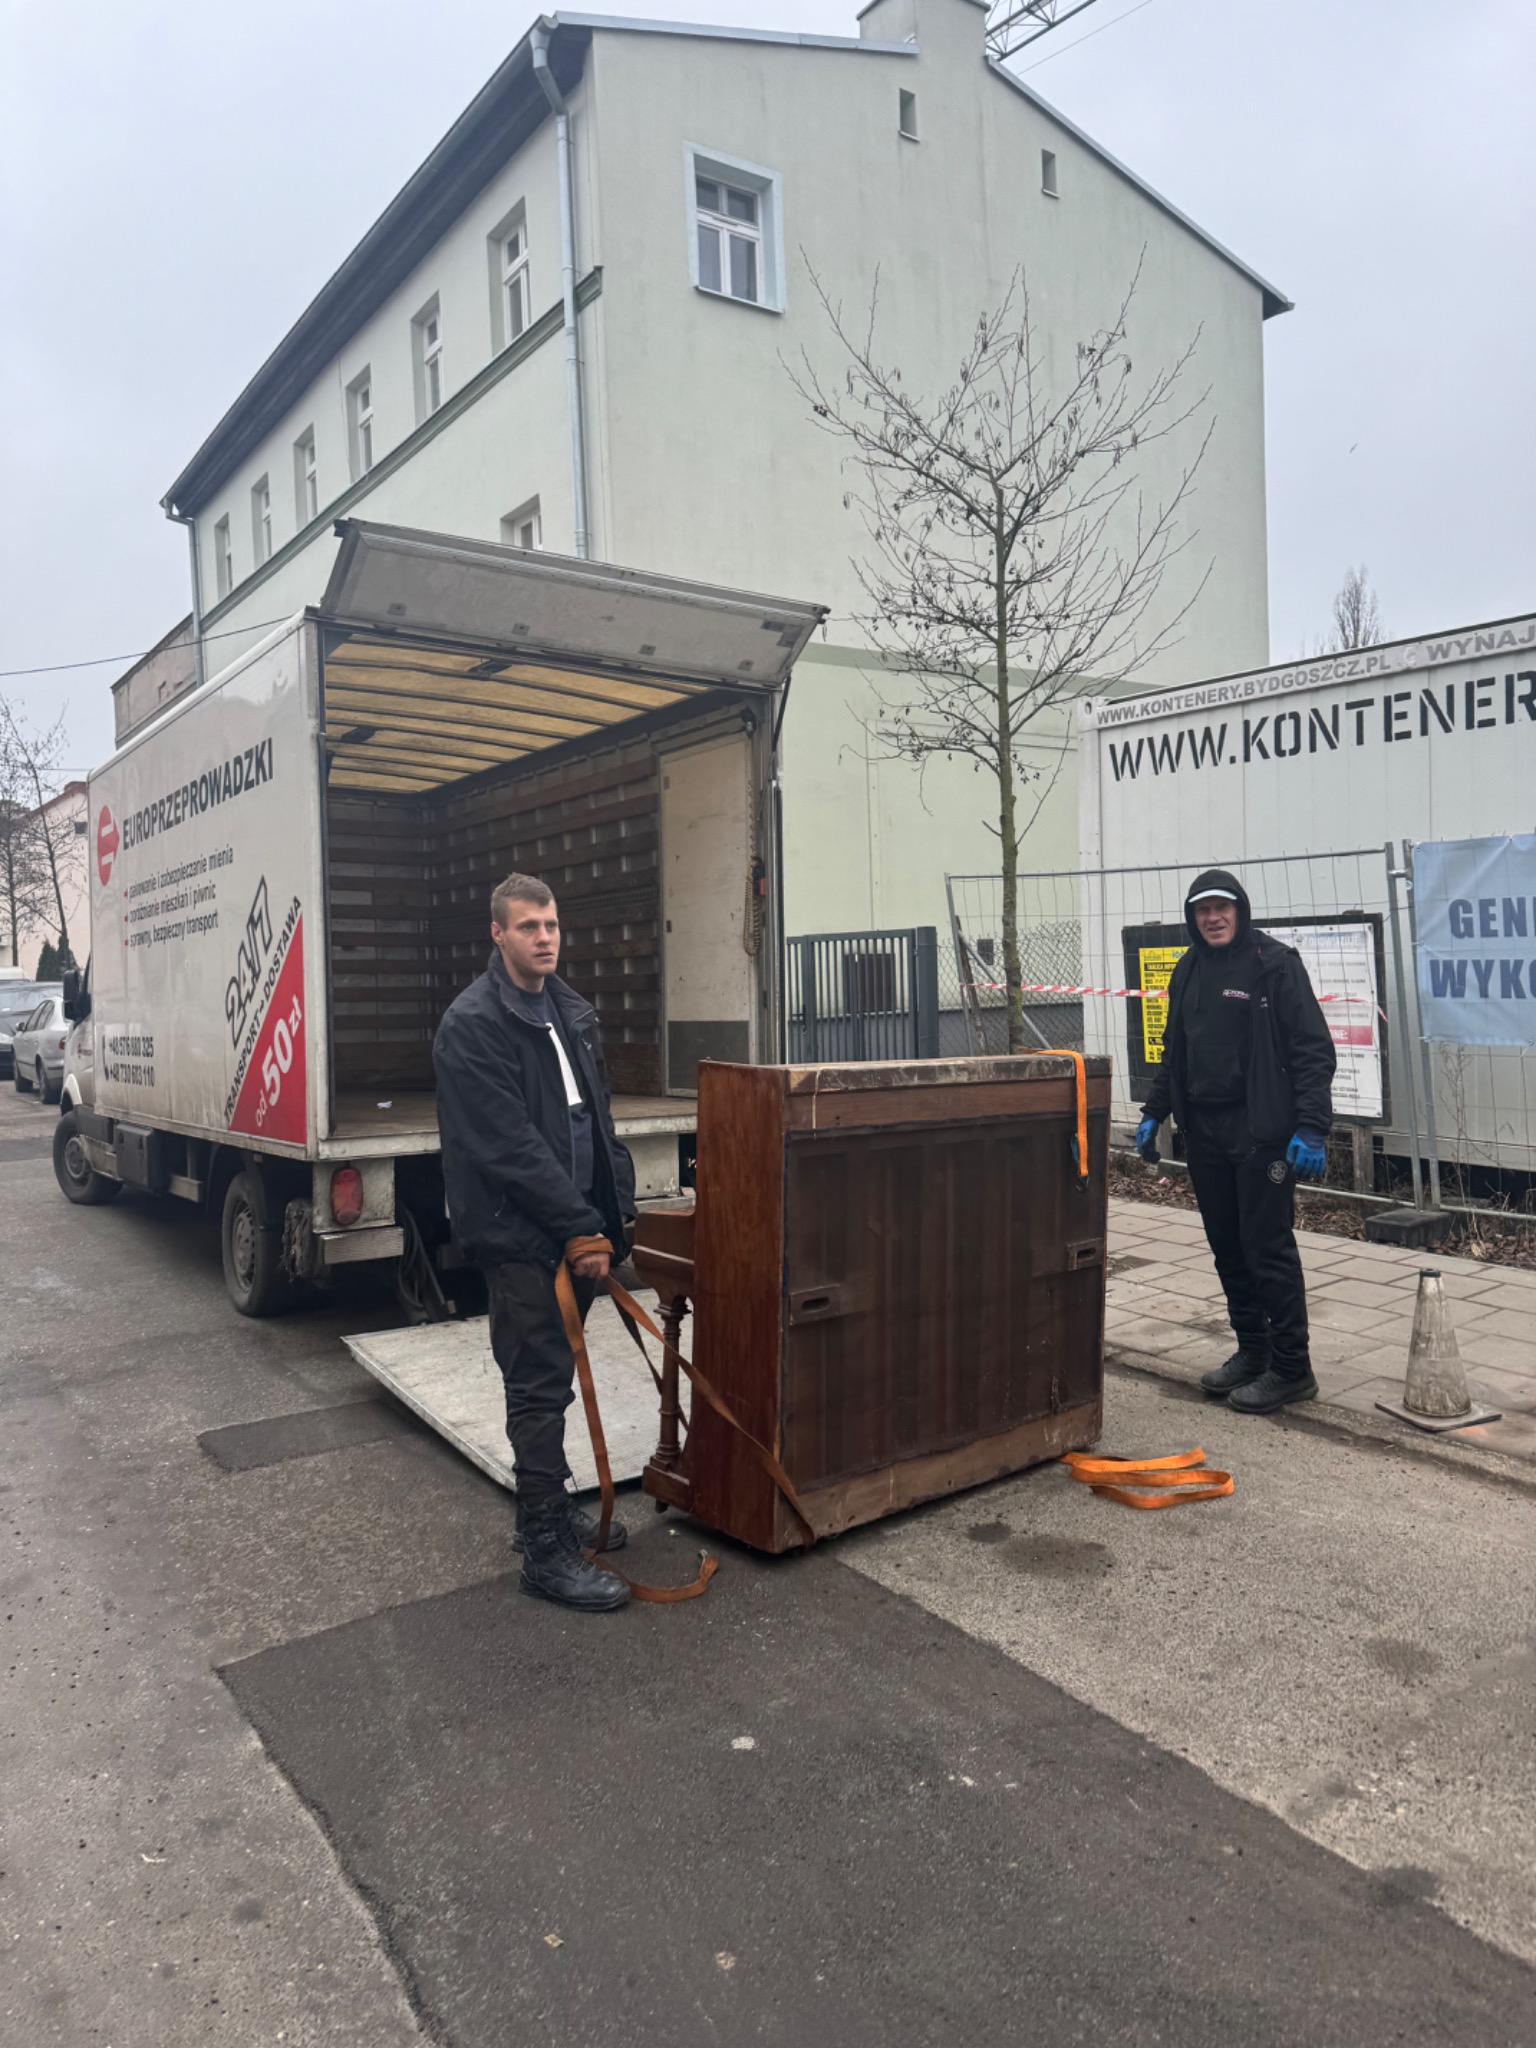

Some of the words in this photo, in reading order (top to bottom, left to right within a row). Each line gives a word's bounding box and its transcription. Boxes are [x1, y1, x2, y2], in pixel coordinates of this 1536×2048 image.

[1097, 655, 1391, 725] WWW.KONTENERY.BYDGOSZCZ.PL
[1109, 670, 1536, 781] WWW.KONTENER
[123, 737, 273, 850] EUROPRZEPROWADZKI
[209, 843, 233, 871] mienia
[186, 909, 219, 936] transport
[225, 874, 273, 1050] 24/7
[1448, 896, 1536, 939] GEN
[223, 1008, 261, 1124] TRANSPORT
[263, 896, 302, 1002] DOSTAWA
[255, 1089, 268, 1127] od
[262, 1018, 293, 1106] 50
[289, 994, 303, 1036] zł
